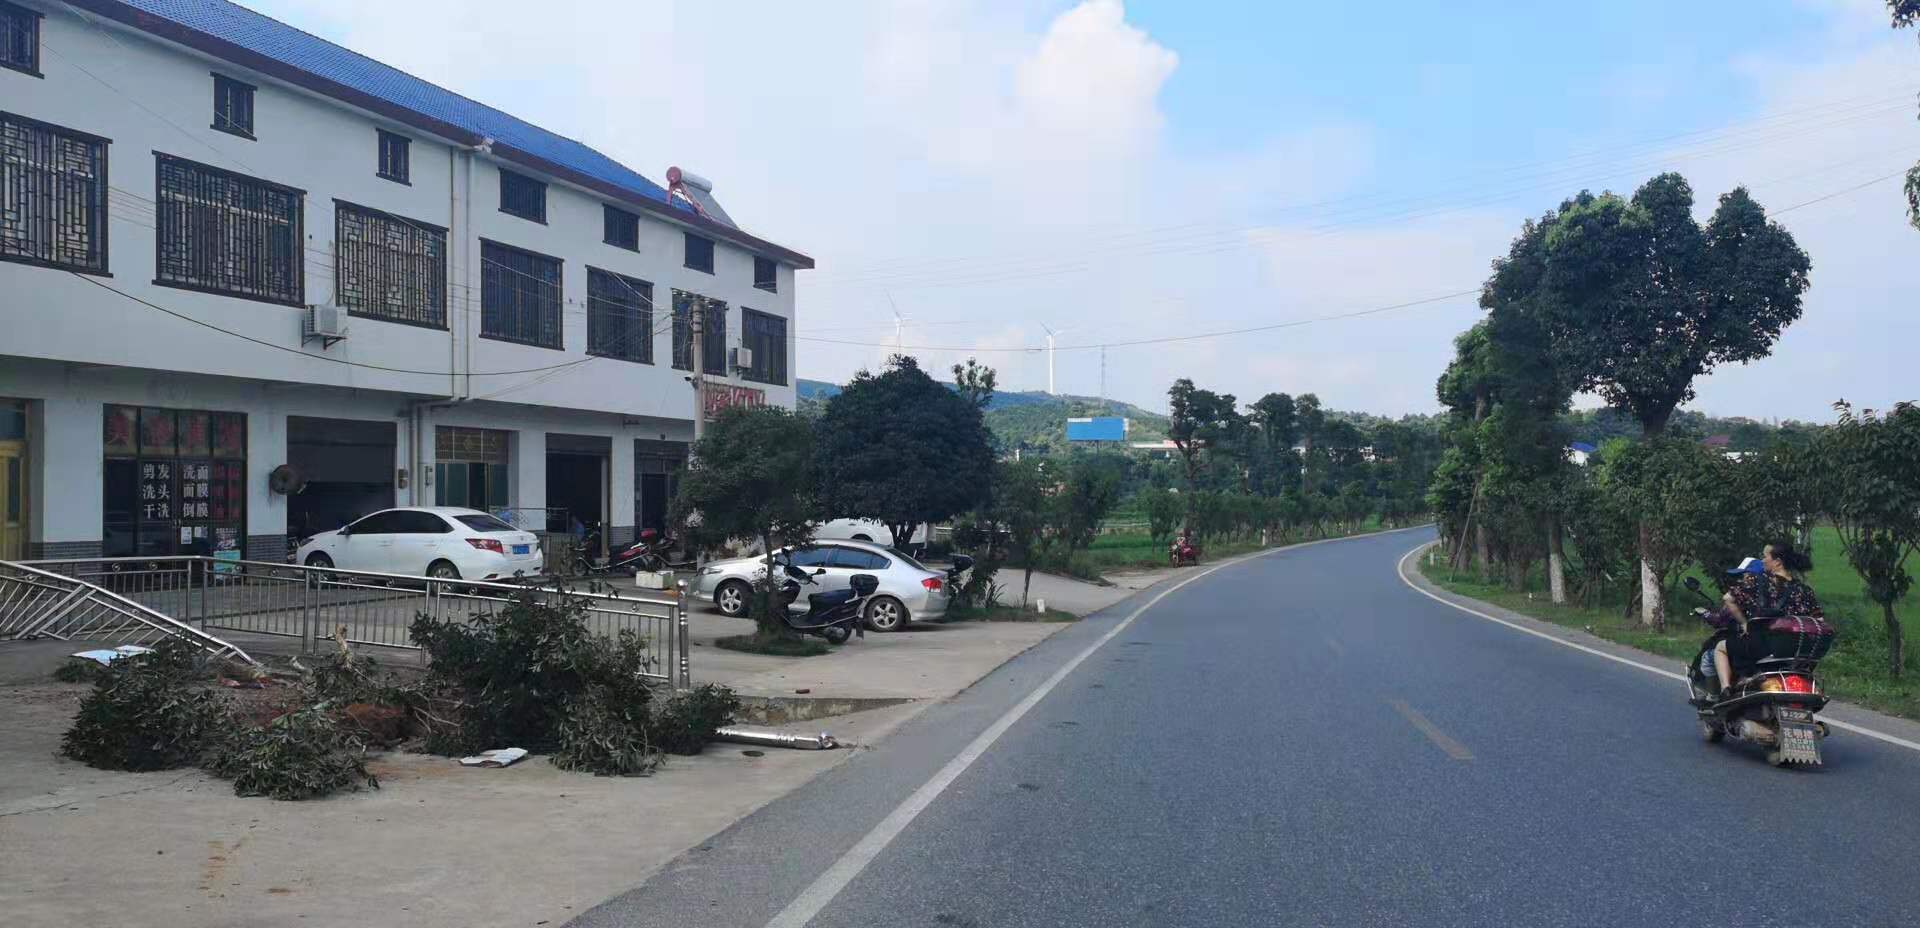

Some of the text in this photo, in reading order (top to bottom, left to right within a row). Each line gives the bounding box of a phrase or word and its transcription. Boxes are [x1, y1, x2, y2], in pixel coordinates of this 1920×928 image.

[144, 463, 170, 480] 剪发
[183, 463, 208, 480] 洗面
[142, 483, 171, 500] 洗头
[183, 482, 208, 498] 面膜
[143, 502, 171, 519] 干洗
[183, 502, 208, 519] 倒膜
